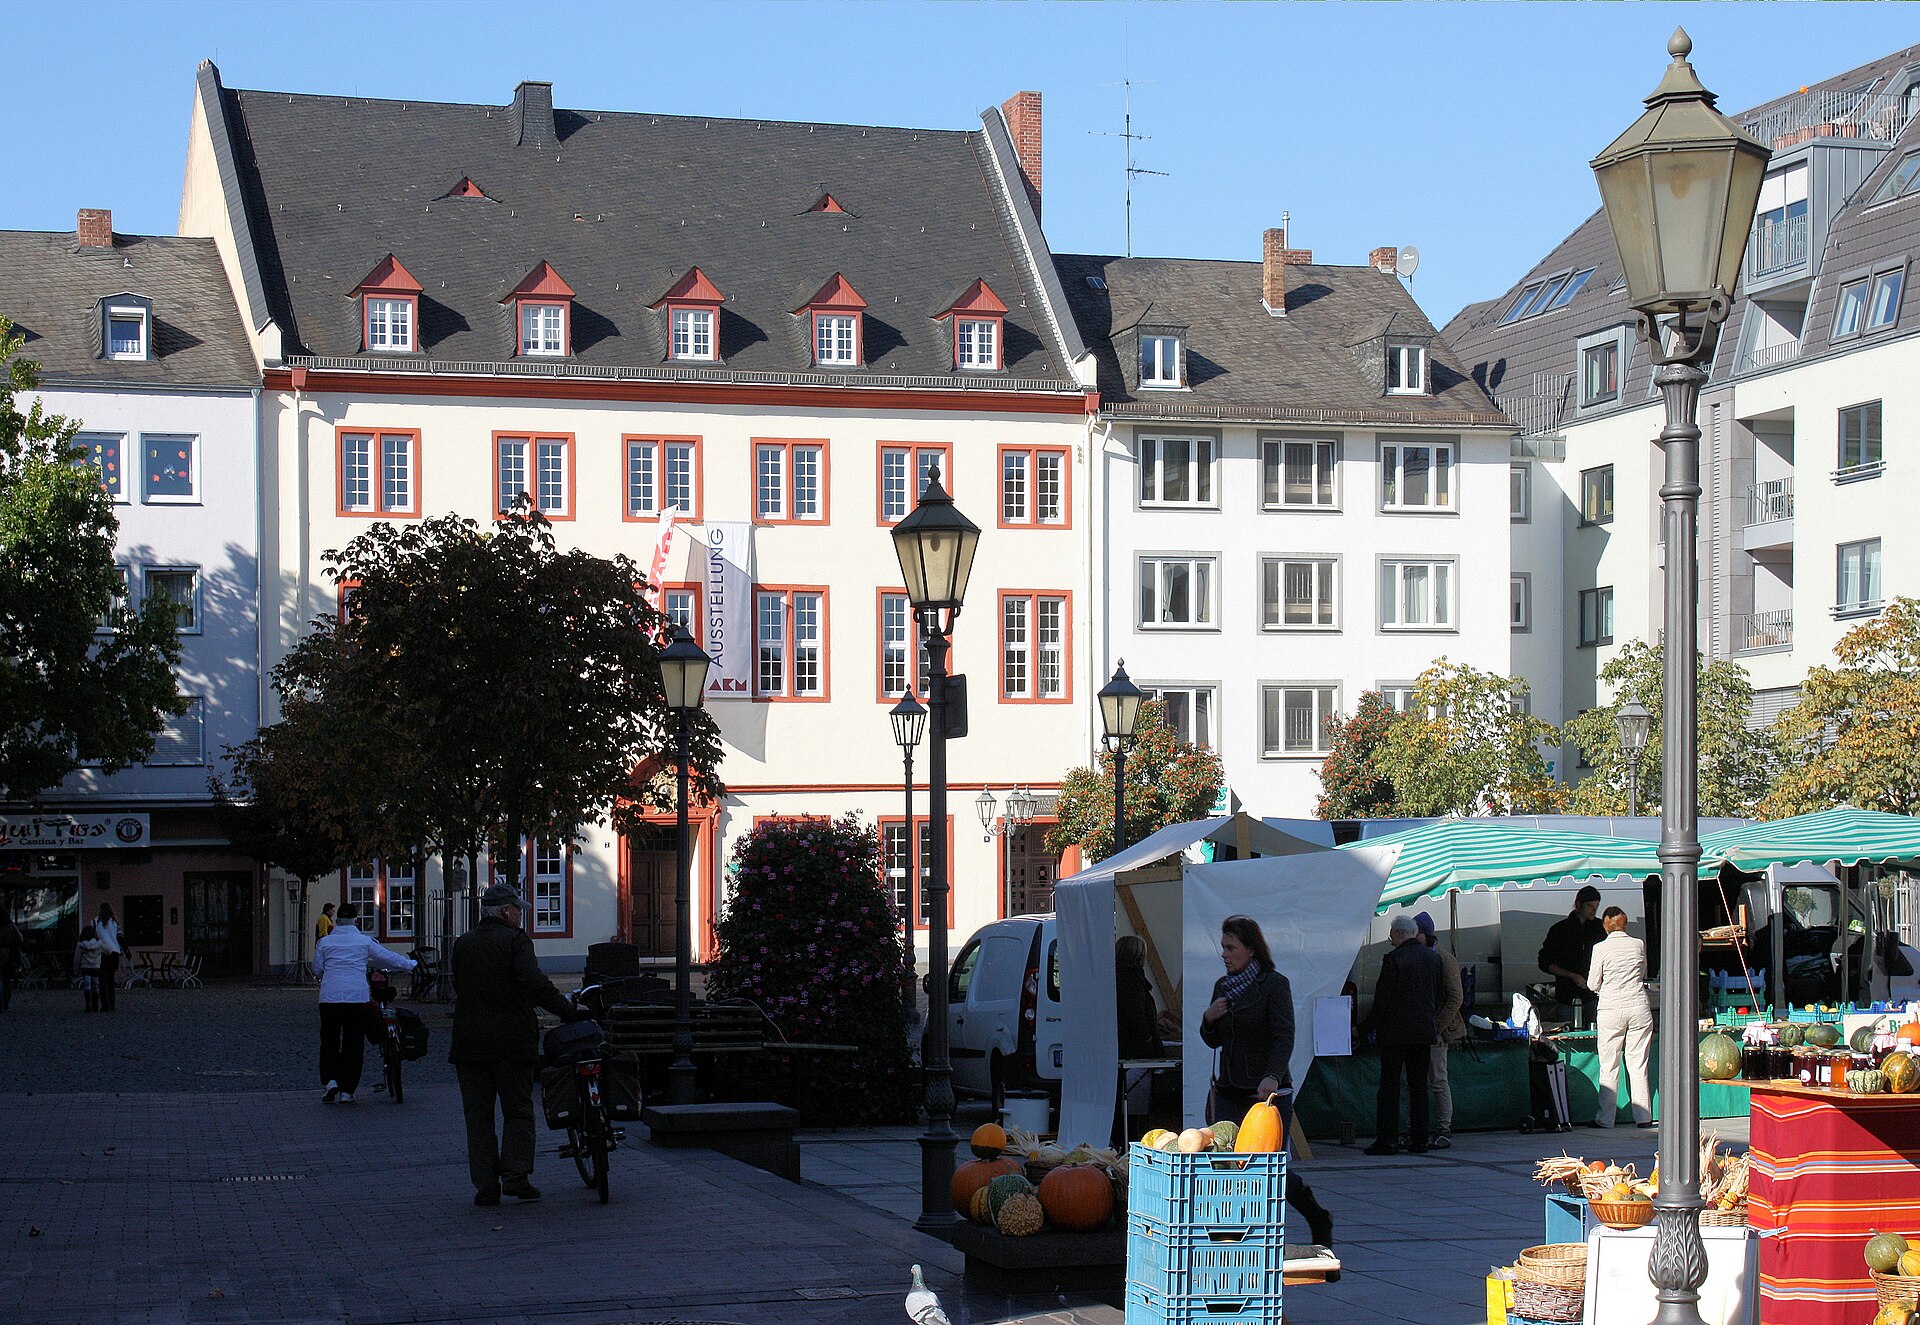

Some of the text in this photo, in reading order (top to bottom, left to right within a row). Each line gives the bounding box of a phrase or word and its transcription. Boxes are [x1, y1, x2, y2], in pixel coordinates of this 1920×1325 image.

[710, 528, 724, 668] AUSSTELLUNG
[19, 837, 84, 847] Cantina y Bar
